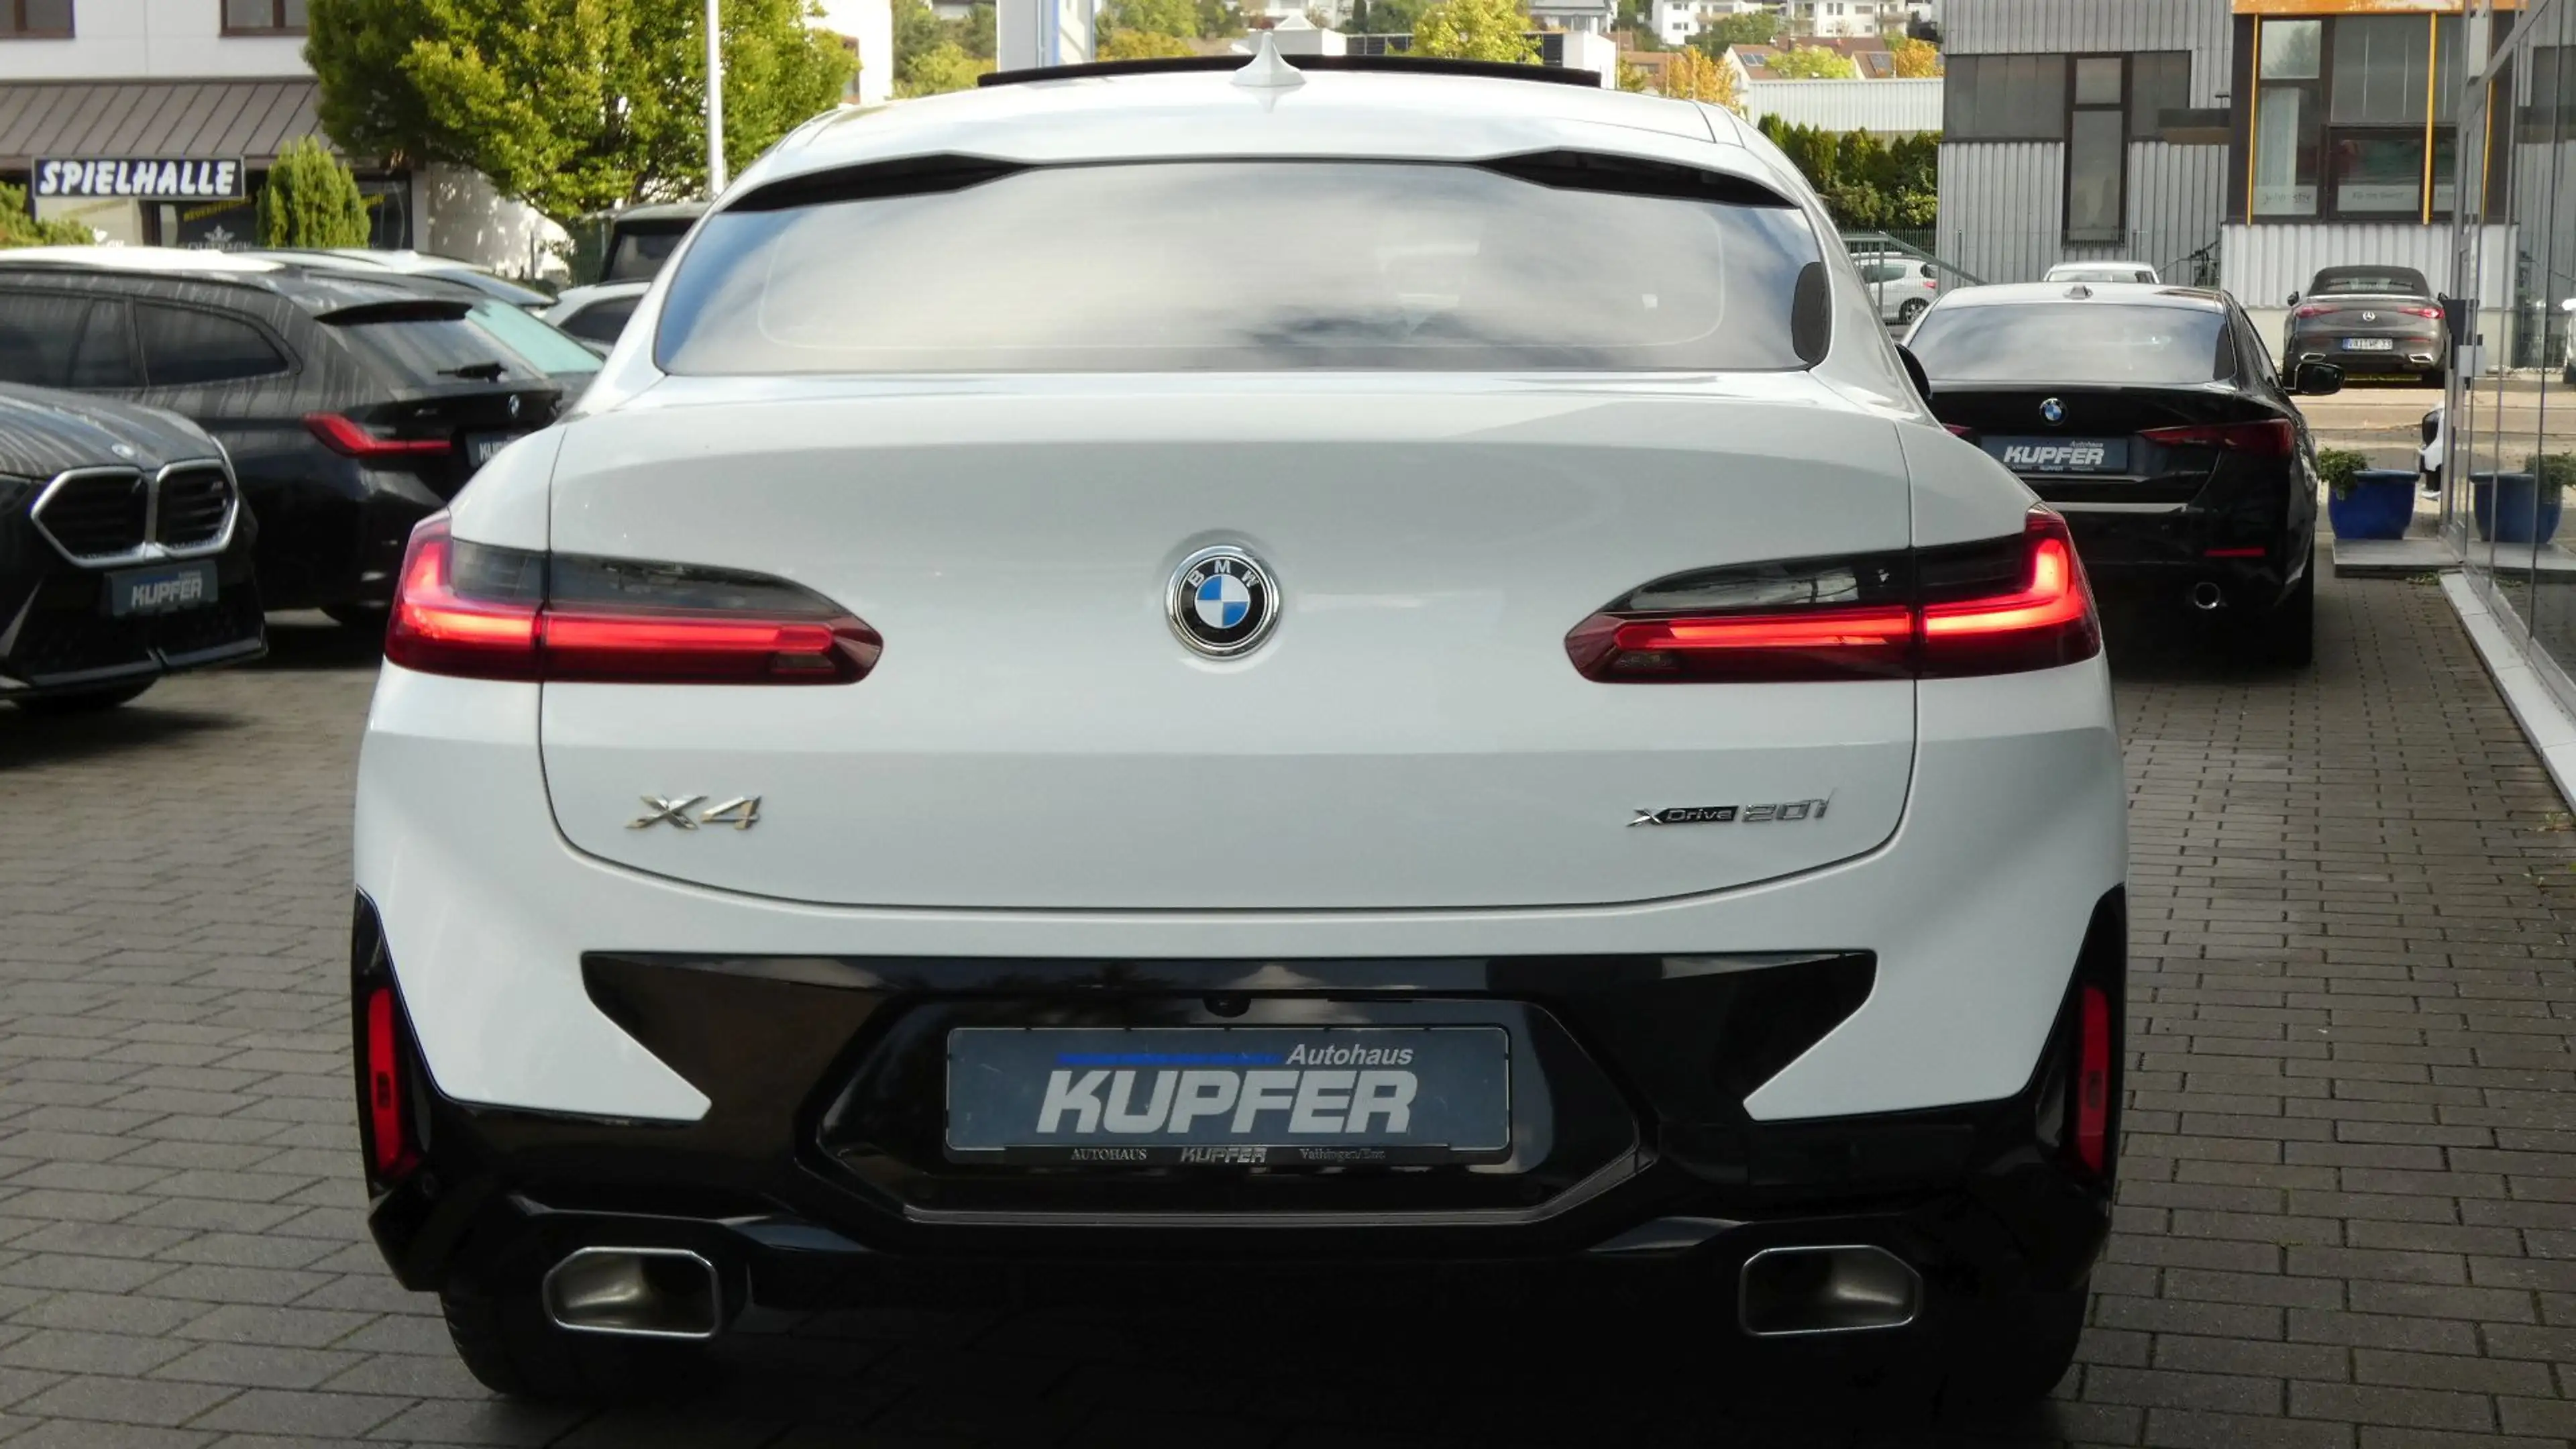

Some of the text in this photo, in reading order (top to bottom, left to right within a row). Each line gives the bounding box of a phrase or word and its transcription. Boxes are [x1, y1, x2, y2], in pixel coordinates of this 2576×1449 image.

[40, 161, 235, 195] SPIELHALLE
[2003, 445, 2104, 465] KUPFER
[1187, 559, 1259, 588] BMW
[131, 578, 203, 609] KUPFER
[625, 795, 763, 830] X4
[1285, 1043, 1413, 1065] Autohaus
[1036, 1070, 1418, 1133] KUPFER
[1071, 1148, 1147, 1161] AUTOHAUS
[1181, 1146, 1267, 1163] KUPFER
